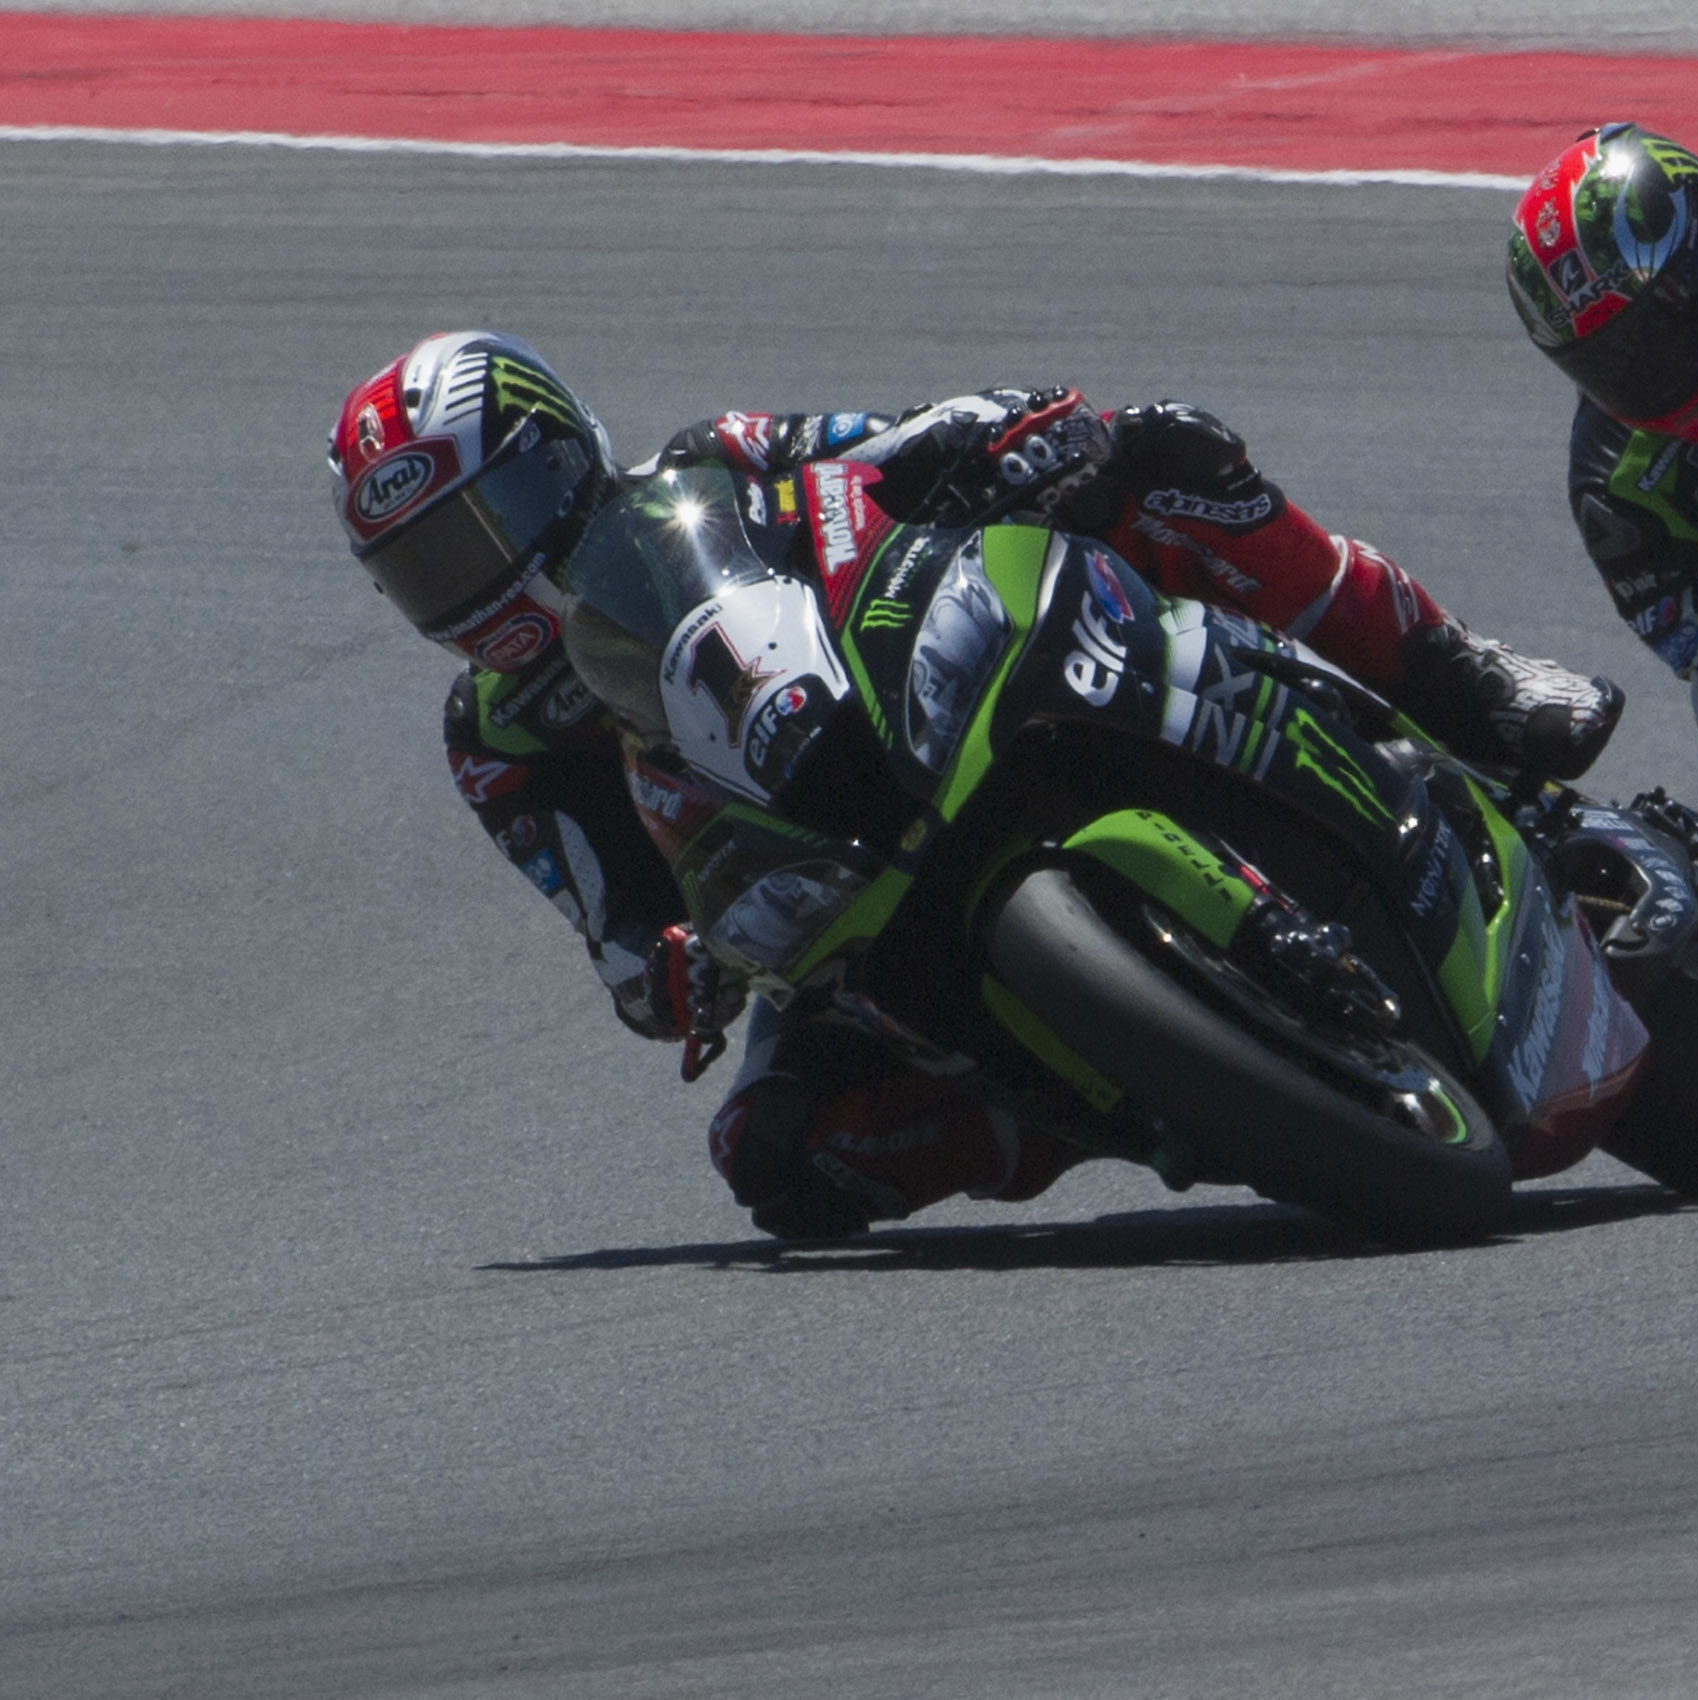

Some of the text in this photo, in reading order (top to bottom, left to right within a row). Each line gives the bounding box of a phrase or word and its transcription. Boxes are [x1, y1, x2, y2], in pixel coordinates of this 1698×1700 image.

[366, 455, 420, 517] Arai
[662, 603, 724, 686] Kawasaki
[686, 620, 787, 750] 1
